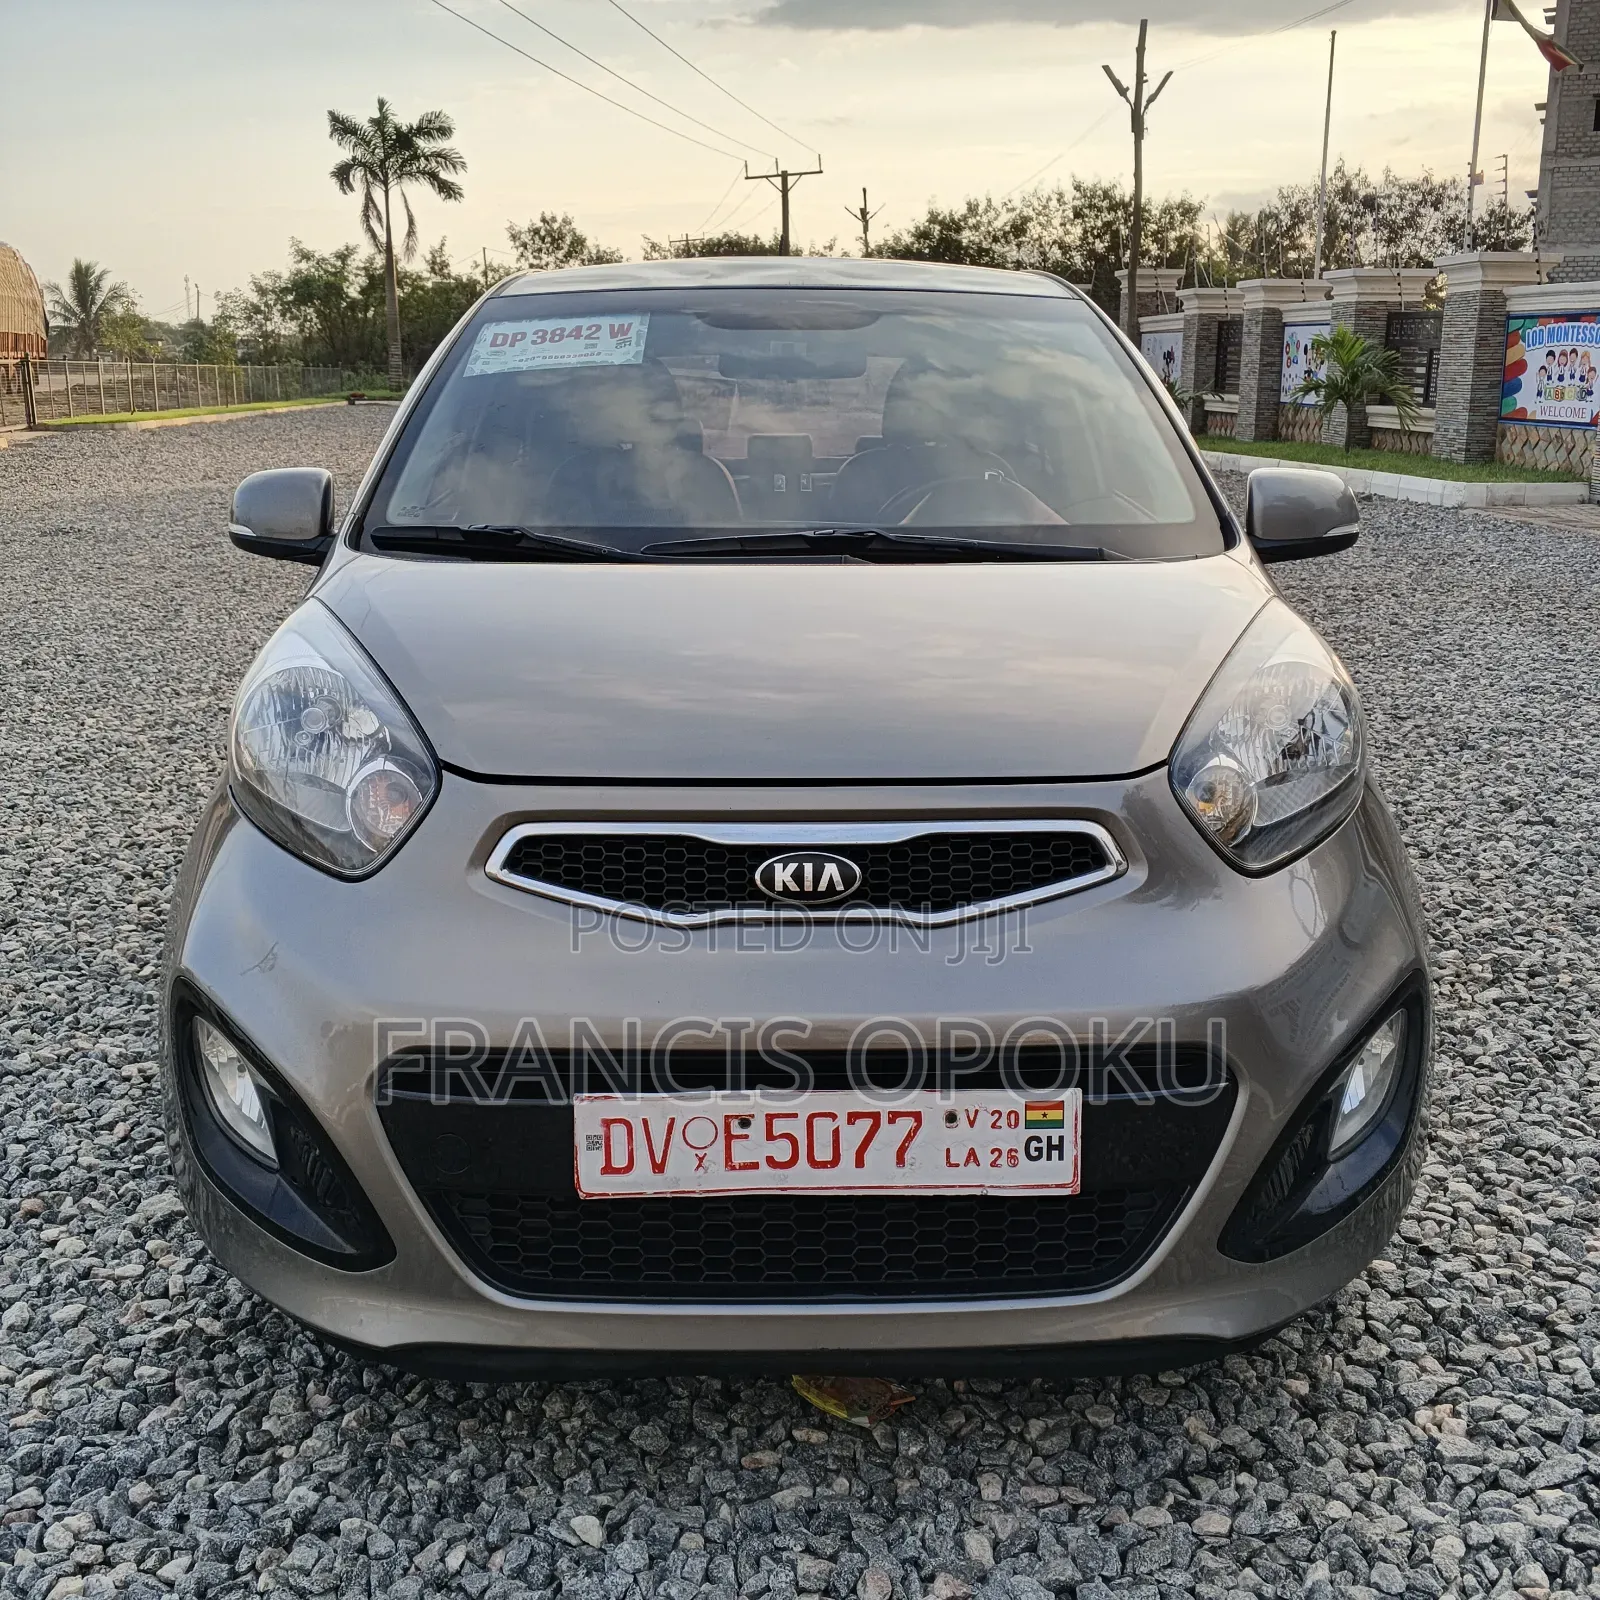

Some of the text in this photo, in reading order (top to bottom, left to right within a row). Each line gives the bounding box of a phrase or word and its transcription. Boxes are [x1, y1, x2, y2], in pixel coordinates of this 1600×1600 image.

[490, 322, 633, 347] DP 3842 W
[1527, 327, 1544, 349] LOD
[1540, 405, 1587, 419] WELCOME
[774, 863, 844, 891] KIA
[964, 1108, 1020, 1129] V 20
[600, 1110, 924, 1176] DV E5077
[1024, 1135, 1064, 1162] GH
[945, 1147, 1020, 1167] LA 26
